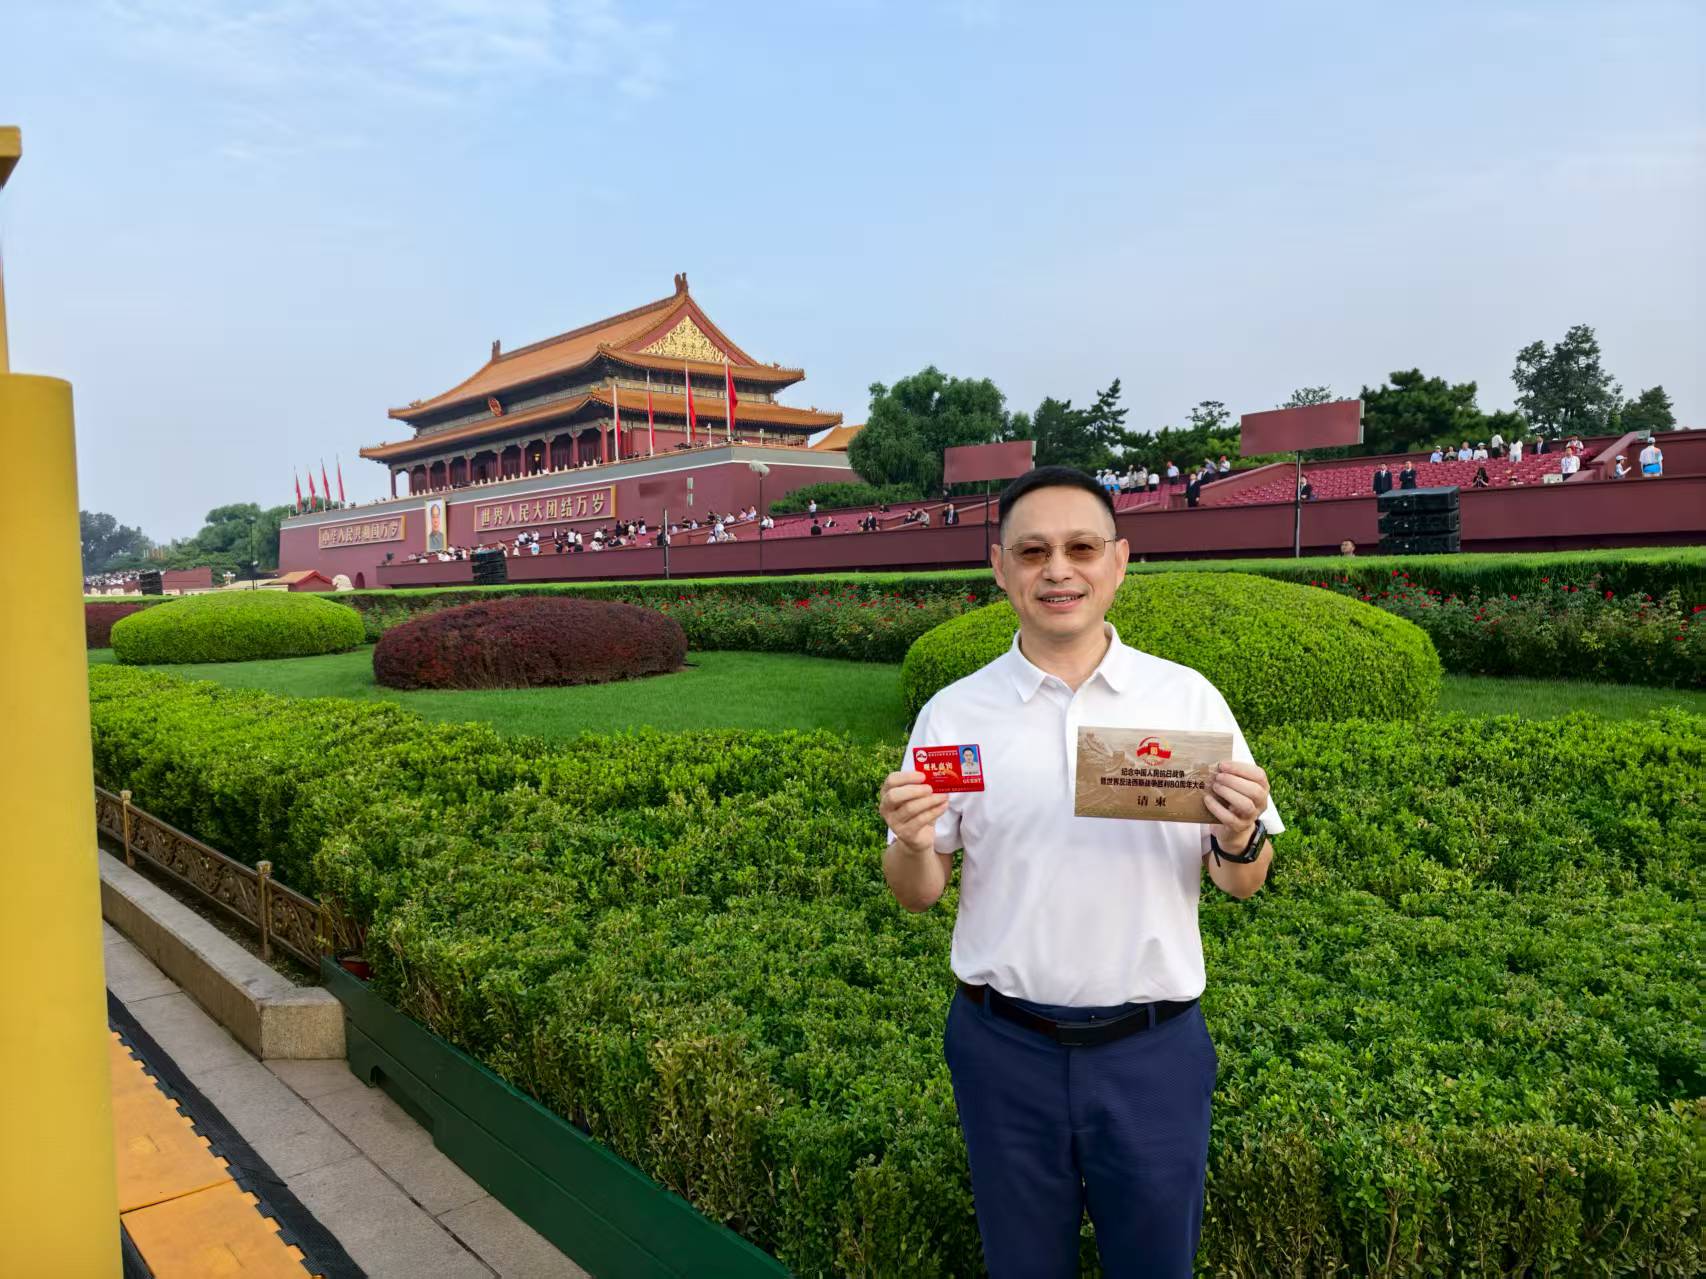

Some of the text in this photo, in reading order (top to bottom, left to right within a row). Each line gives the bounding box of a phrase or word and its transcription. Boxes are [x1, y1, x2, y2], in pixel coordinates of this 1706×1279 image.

[481, 493, 605, 527] 世界人民大团结万岁
[321, 521, 399, 545] 中华人民共和国万岁
